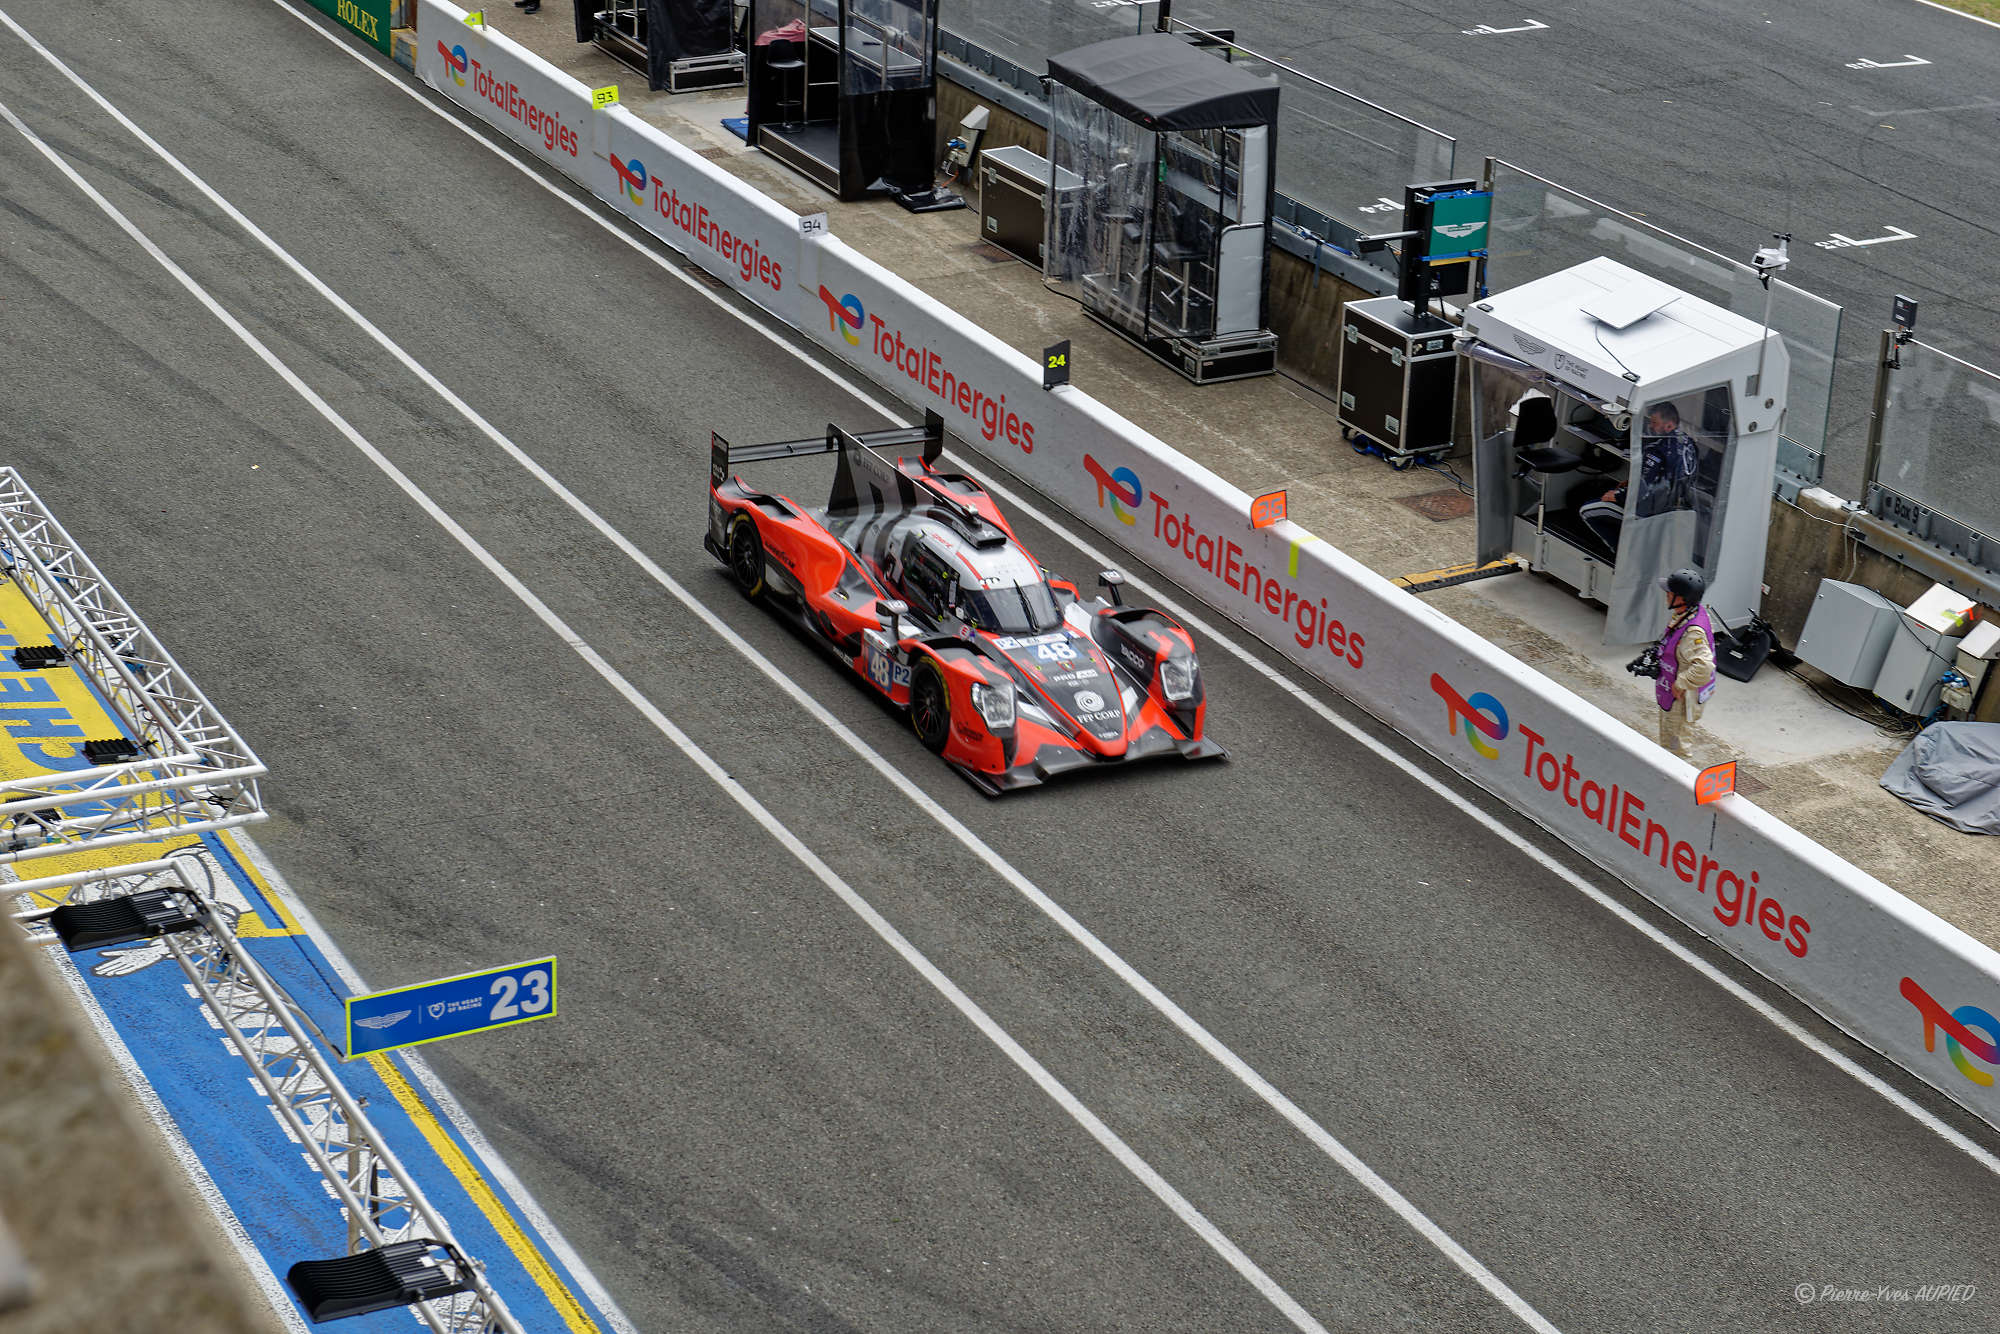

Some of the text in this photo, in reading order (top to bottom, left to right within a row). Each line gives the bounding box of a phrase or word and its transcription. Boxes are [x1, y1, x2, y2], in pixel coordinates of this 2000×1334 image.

[337, 0, 379, 41] ROLEX
[471, 58, 578, 157] TotalEnergies
[596, 91, 614, 104] 93
[651, 175, 783, 292] TotalEnergies
[803, 219, 821, 233] 94
[1048, 354, 1066, 368] 24
[869, 313, 1035, 454] TotalEnergies
[1894, 496, 1920, 524] Box 9
[1149, 490, 1366, 669] TotalEnergies
[870, 651, 890, 687] 48
[1038, 642, 1077, 661] 48
[894, 665, 911, 684] P2
[1703, 768, 1731, 796] 35
[1518, 723, 1811, 959] TotalEnergies
[489, 969, 550, 1022] 23
